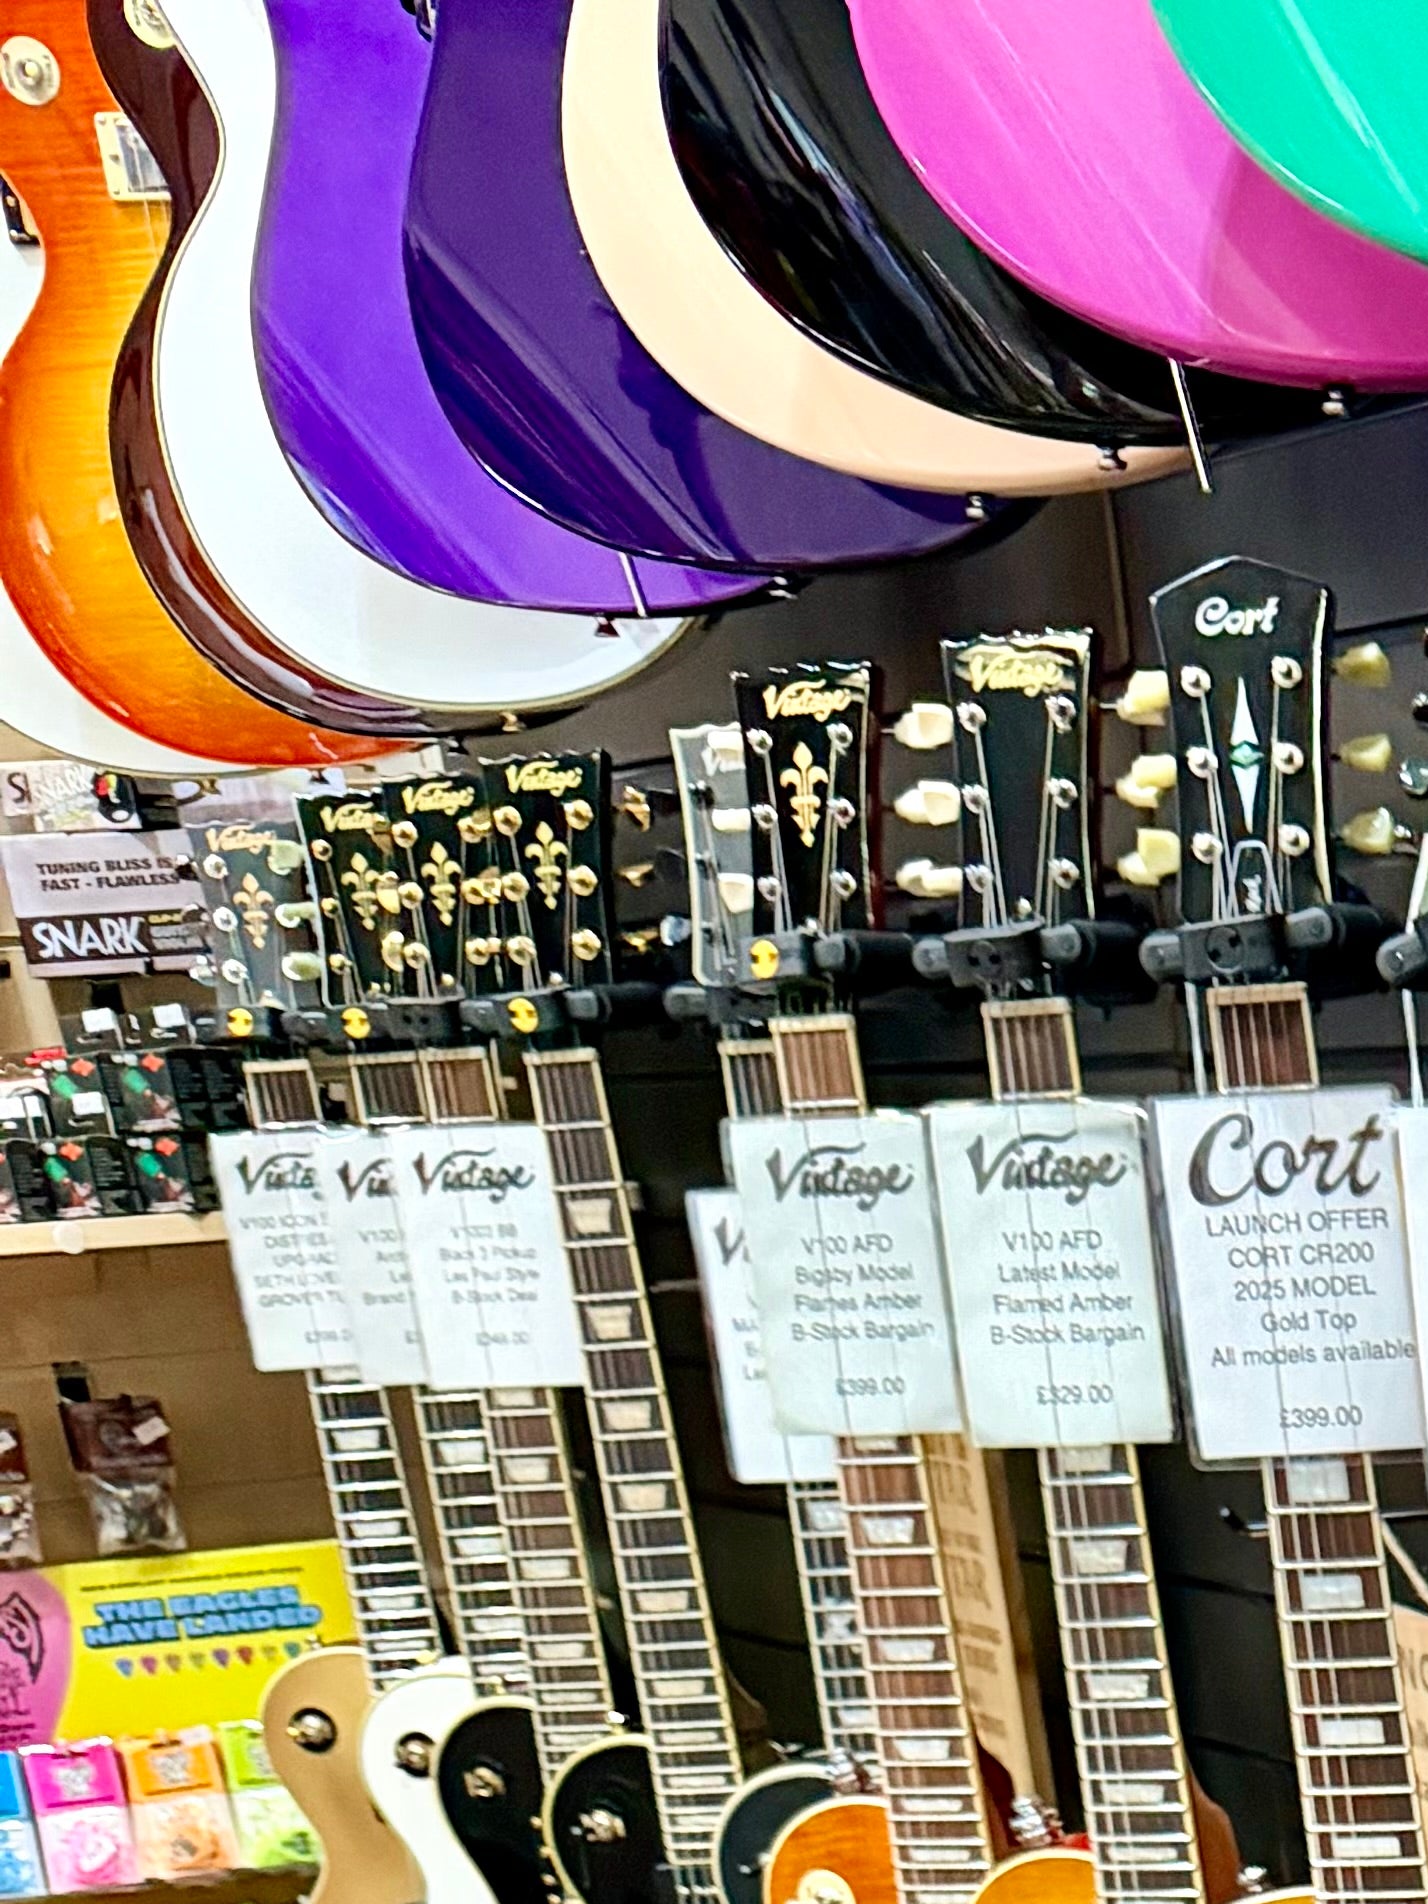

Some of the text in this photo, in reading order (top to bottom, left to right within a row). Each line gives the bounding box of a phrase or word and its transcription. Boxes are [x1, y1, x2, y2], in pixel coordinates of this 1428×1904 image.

[1195, 597, 1278, 636] Cort
[968, 653, 1066, 693] Vintage
[763, 679, 851, 722] Vintage
[505, 760, 582, 796] Vintage
[401, 780, 475, 816] Vintage
[36, 856, 152, 876] TUNING BLISS
[40, 878, 80, 891] FAST
[32, 916, 150, 958] SNARK
[412, 1147, 535, 1203] Vintage
[965, 1129, 1130, 1206] Vintage
[1188, 1112, 1385, 1208] Cort
[765, 1142, 915, 1212] Vintage
[1205, 1208, 1388, 1238] LAUNCH OFFER
[802, 1234, 893, 1256] V100 AFD
[1002, 1229, 1103, 1252] V100 AFD
[1228, 1240, 1375, 1270] CORT CR200
[859, 1263, 915, 1282] Model
[998, 1262, 1121, 1284] Latest Model
[1233, 1273, 1376, 1302] 2025 MODEL
[864, 1292, 923, 1312] Amber
[993, 1292, 1133, 1315] Flamed Amber
[791, 1321, 935, 1343] B-Stock Bargain
[990, 1323, 1145, 1347] B-Stock Bargain
[1260, 1309, 1358, 1336] Gold Top
[1210, 1338, 1417, 1368] All models available
[1279, 1404, 1364, 1429] £399.00
[95, 1584, 300, 1623] THE EAGLES
[83, 1603, 323, 1649] HAVE LANDED
